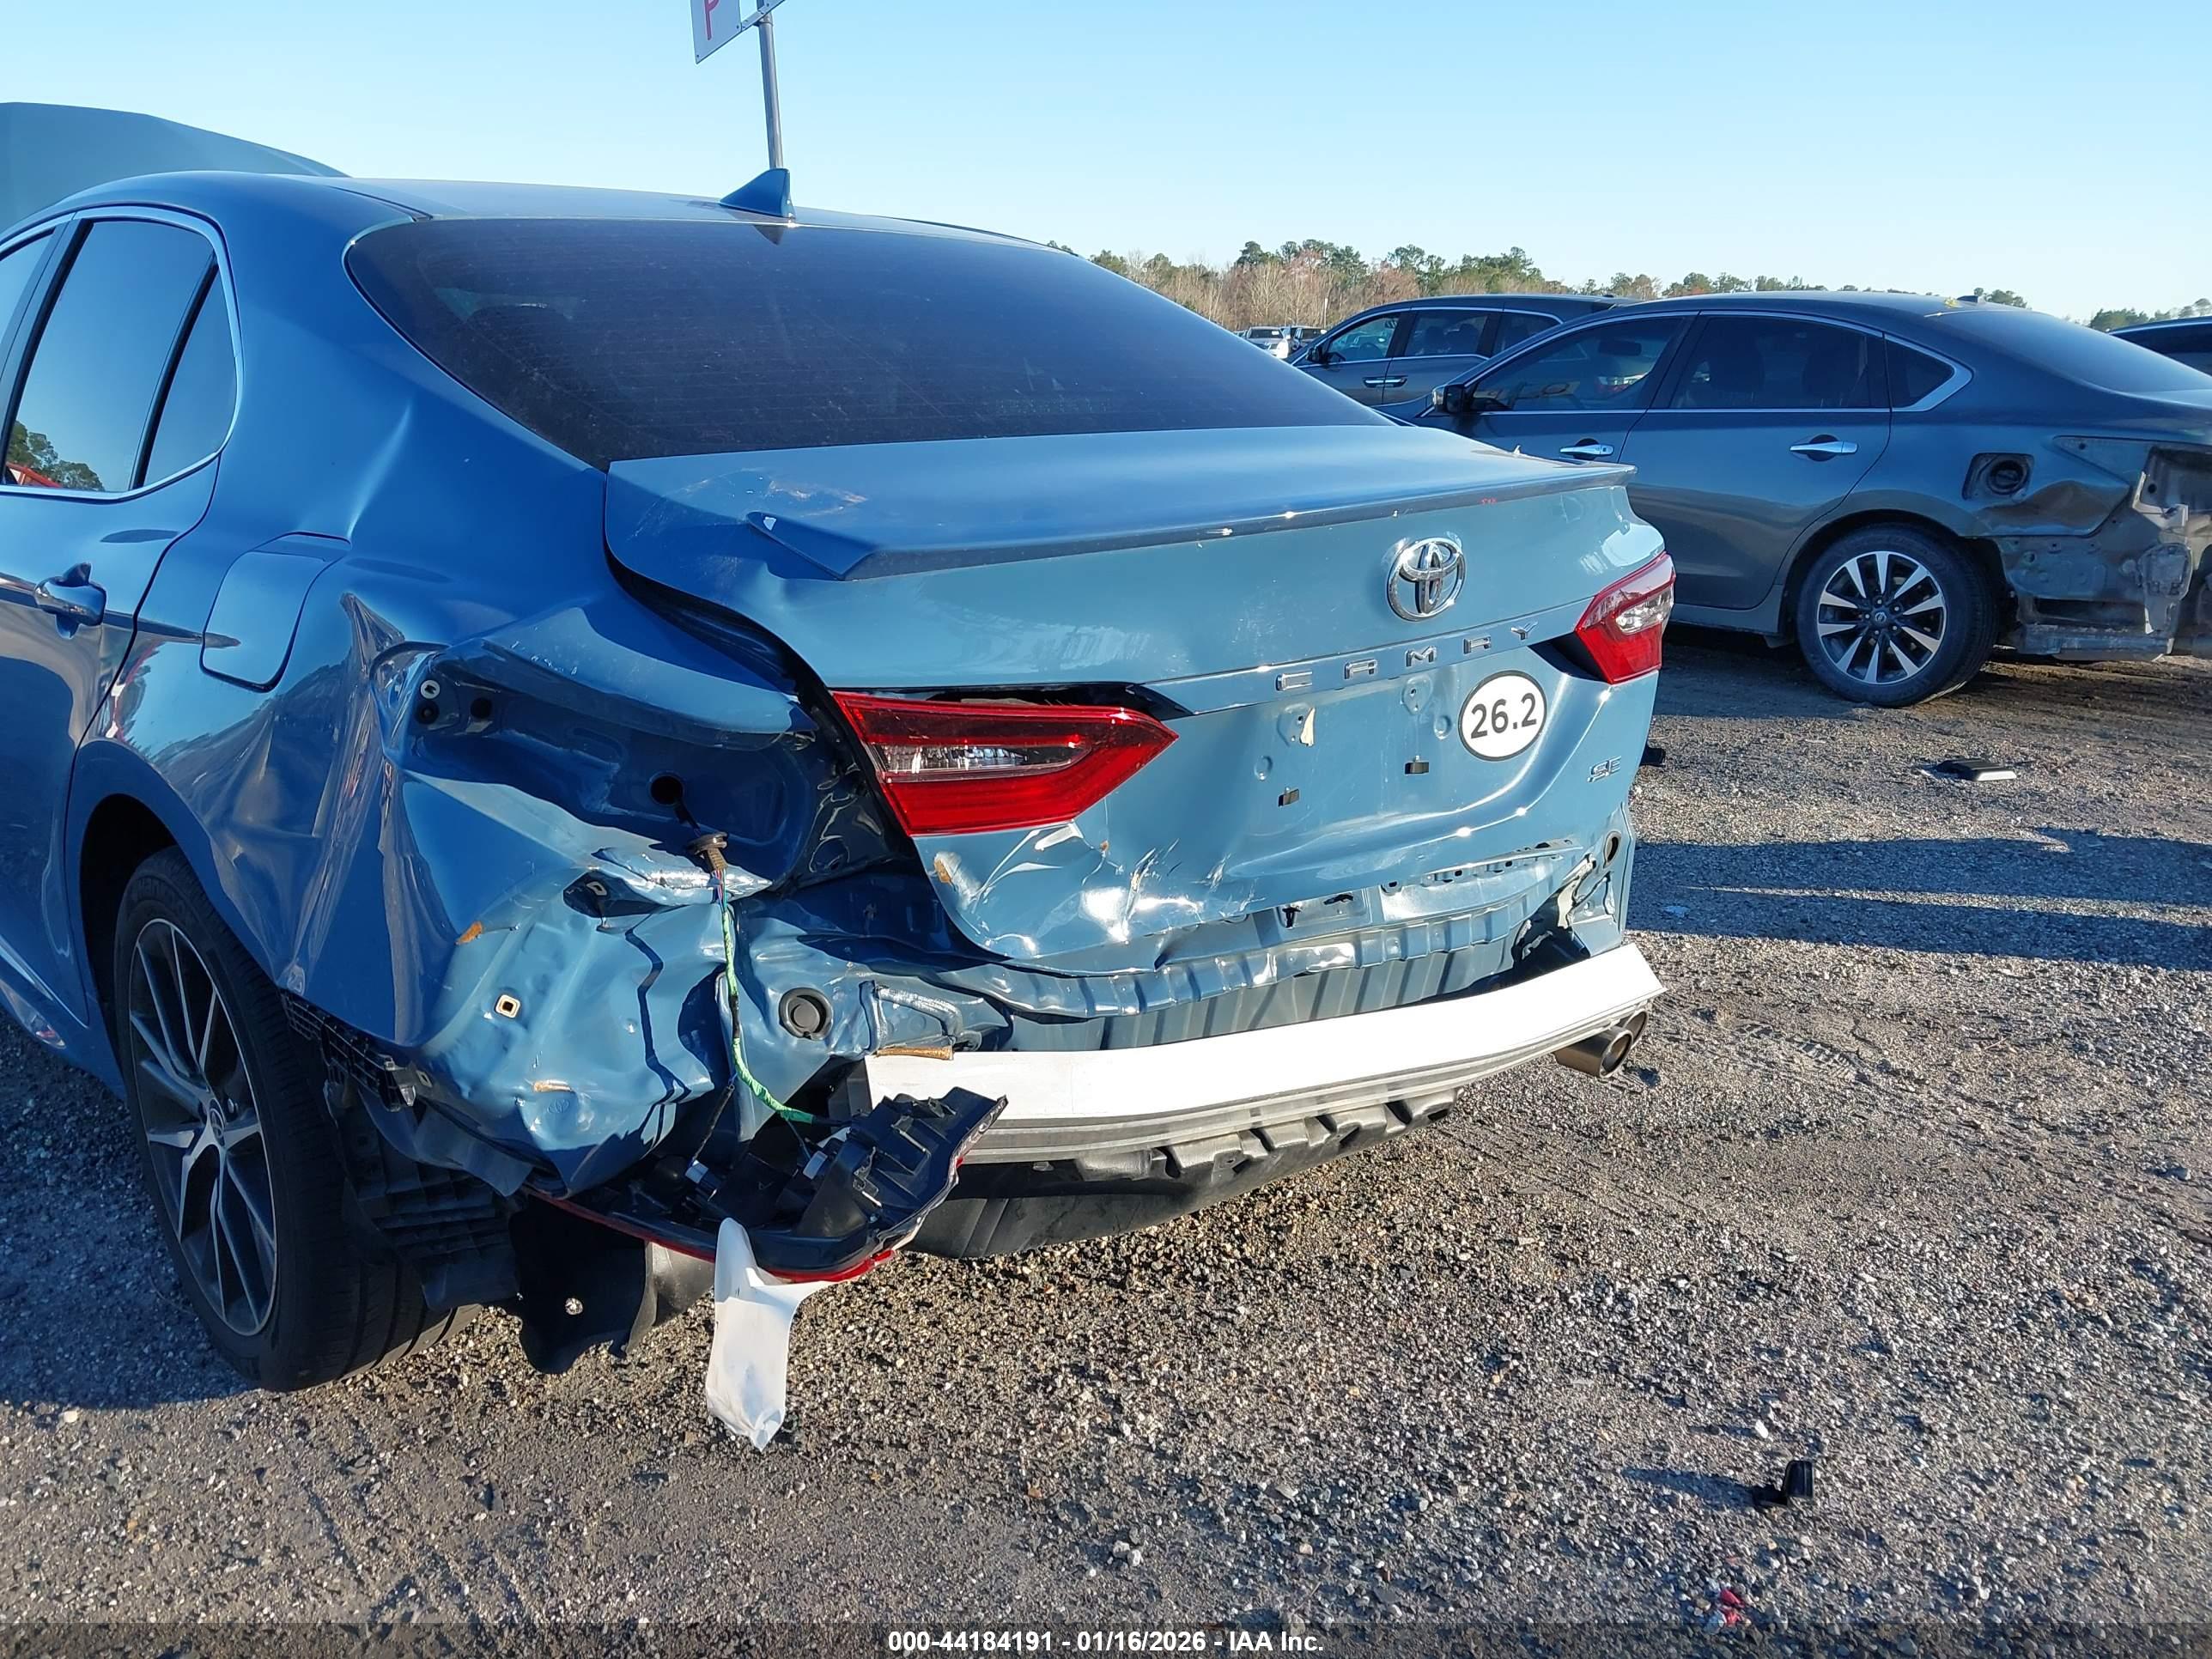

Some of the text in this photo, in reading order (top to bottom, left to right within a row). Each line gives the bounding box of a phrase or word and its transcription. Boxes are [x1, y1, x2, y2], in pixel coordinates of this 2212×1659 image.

[1275, 622, 1538, 691] CAMRY
[1470, 692, 1537, 739] 26.2
[1587, 756, 1622, 782] SE
